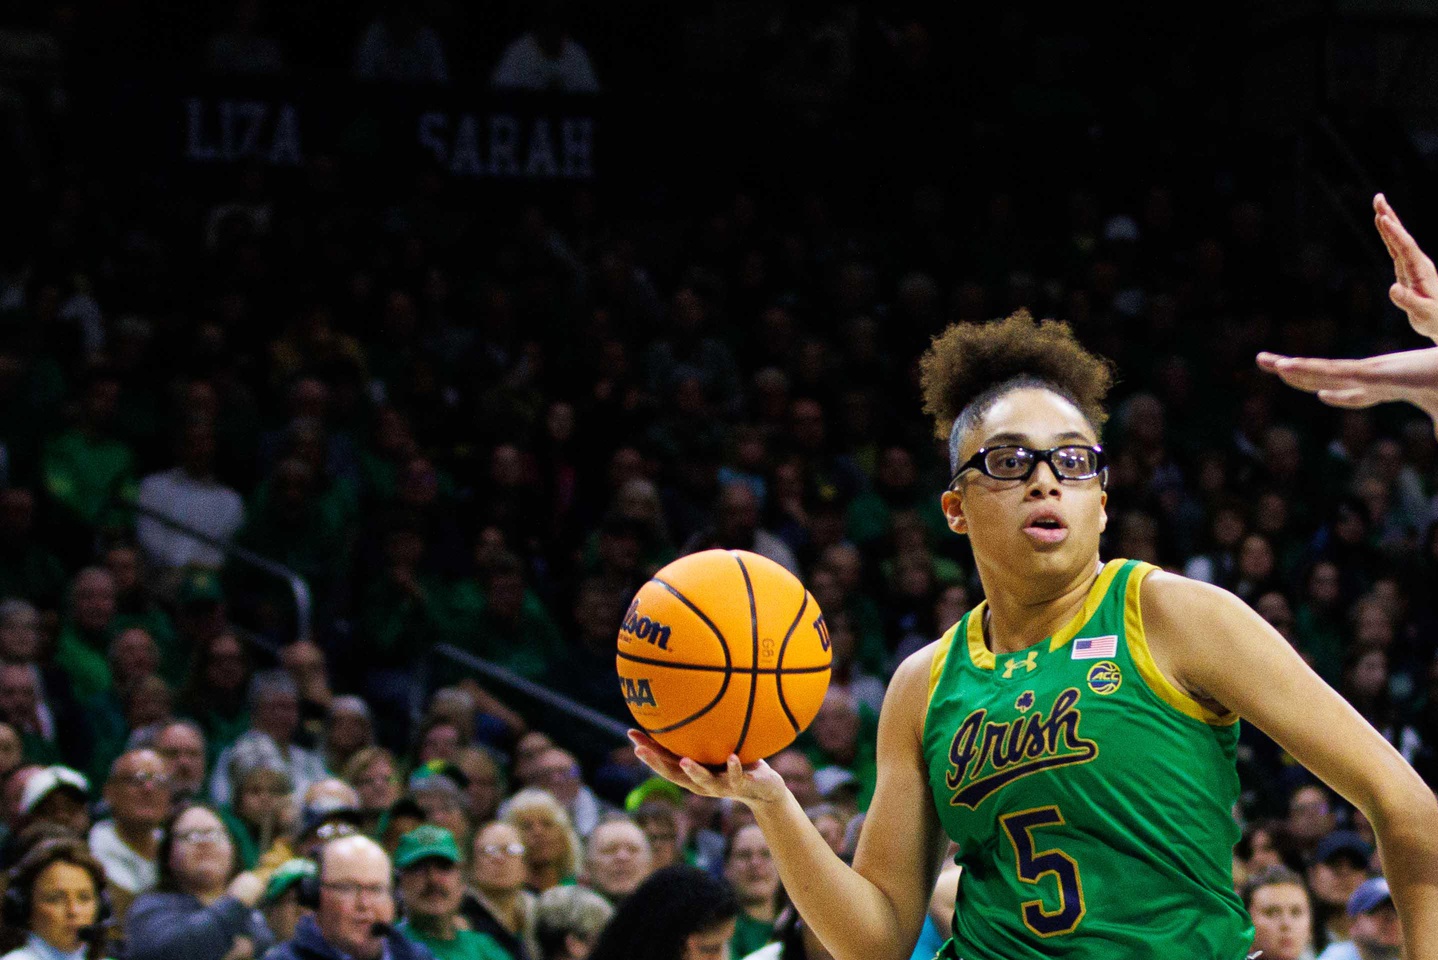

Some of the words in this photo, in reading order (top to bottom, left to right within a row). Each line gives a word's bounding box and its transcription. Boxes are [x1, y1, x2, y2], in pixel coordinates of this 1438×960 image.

[184, 97, 300, 168] LIZA
[416, 108, 597, 177] SARAH
[621, 598, 669, 651] lson
[946, 687, 1099, 811] Irish
[999, 805, 1087, 938] 5
